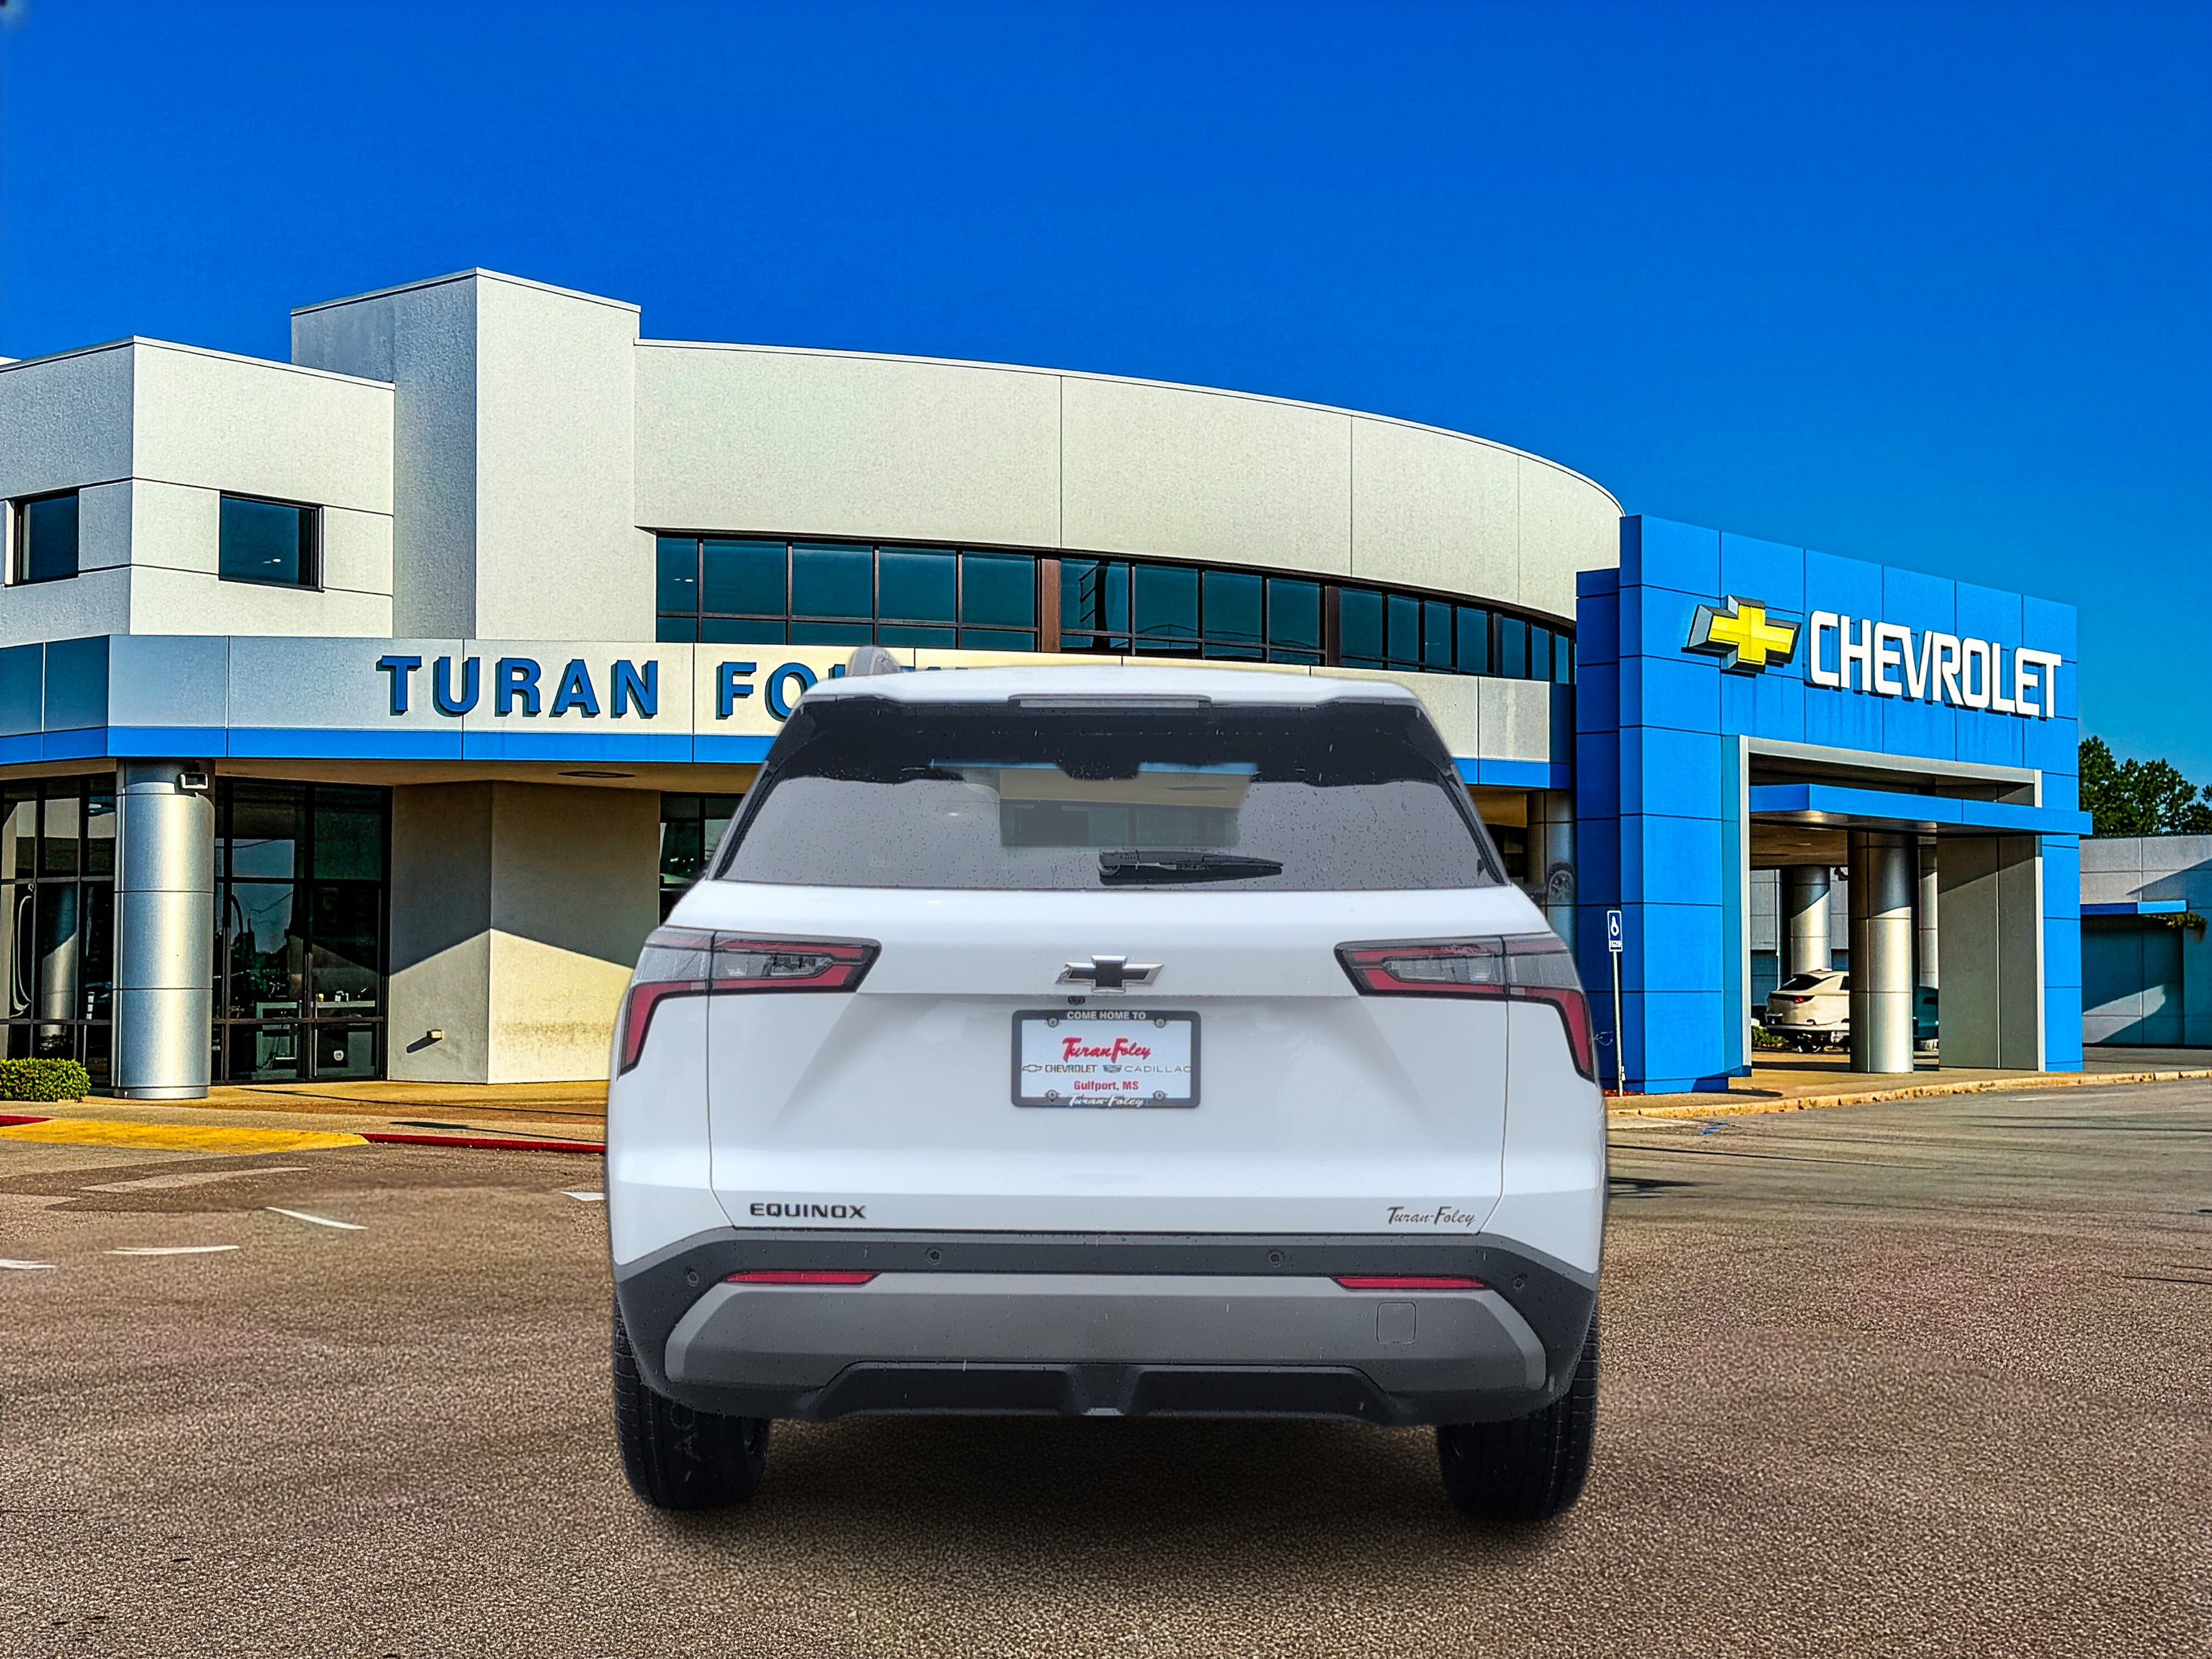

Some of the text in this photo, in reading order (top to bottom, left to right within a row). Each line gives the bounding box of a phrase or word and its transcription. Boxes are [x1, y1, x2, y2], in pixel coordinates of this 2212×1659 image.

[1808, 610, 2062, 719] CHEVROLET
[376, 655, 659, 718] TURAN
[1066, 1011, 1147, 1020] COME HOME TO
[1062, 1037, 1152, 1064] Turan Foley
[1045, 1064, 1097, 1073] CHEVROLET
[1074, 1081, 1139, 1091] Gulfport, MS
[750, 1203, 866, 1219] EQUINOX
